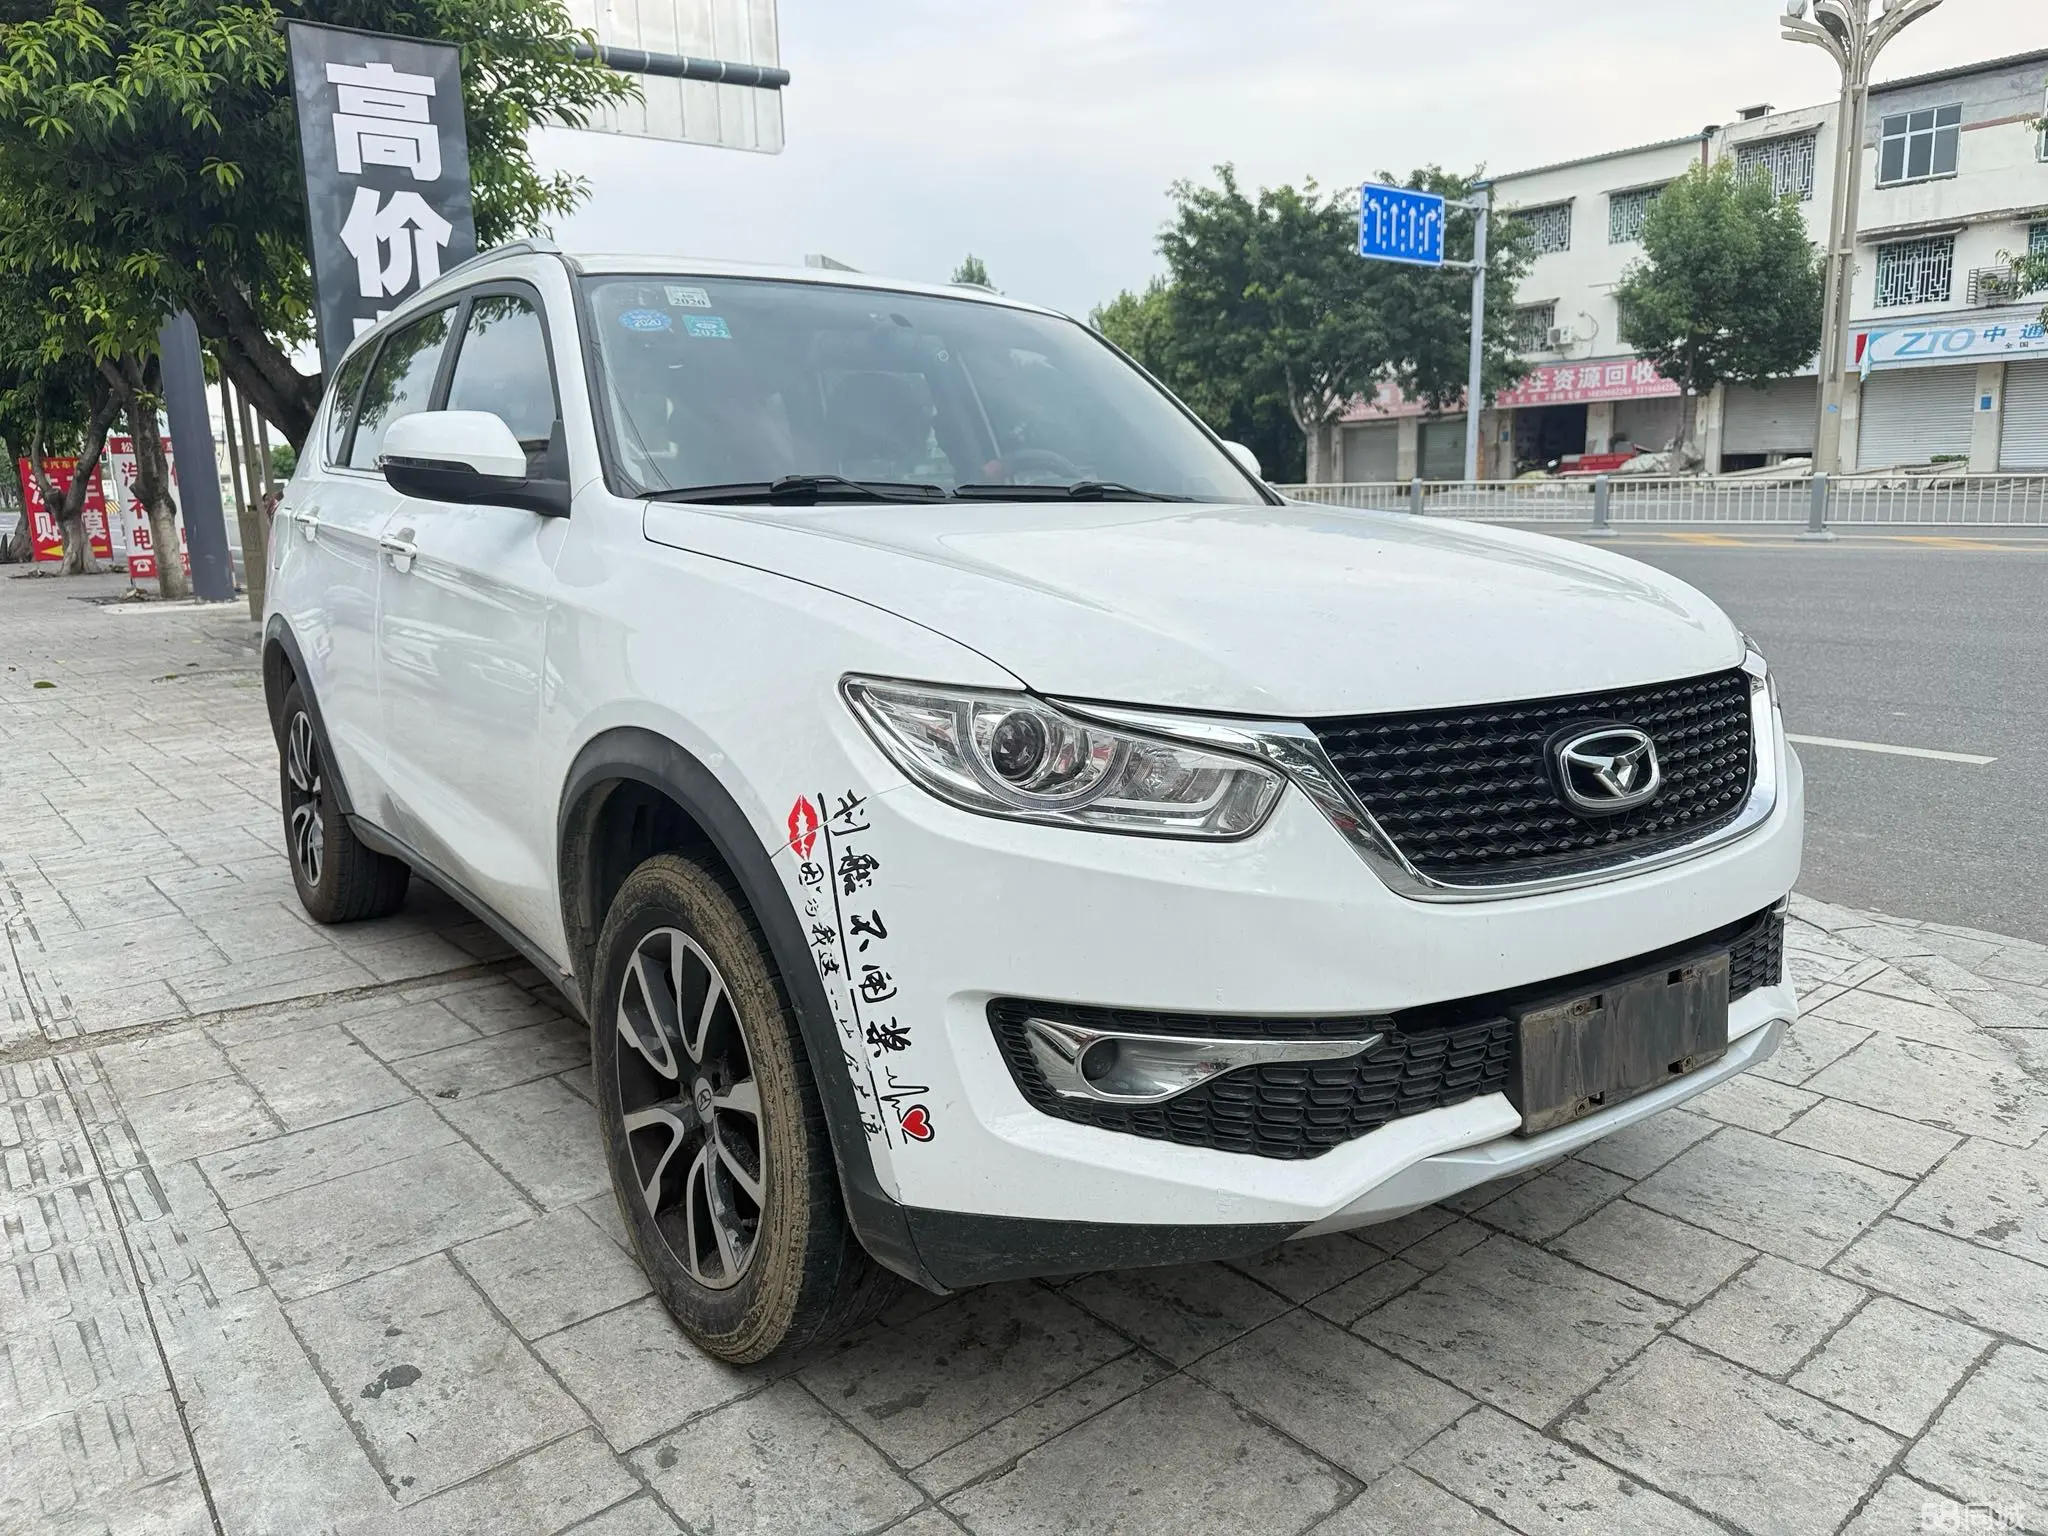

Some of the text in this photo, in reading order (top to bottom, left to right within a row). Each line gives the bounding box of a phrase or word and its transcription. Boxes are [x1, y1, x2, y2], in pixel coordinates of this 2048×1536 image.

[326, 61, 453, 337] 高价
[1894, 323, 2045, 356] ZTO 中通
